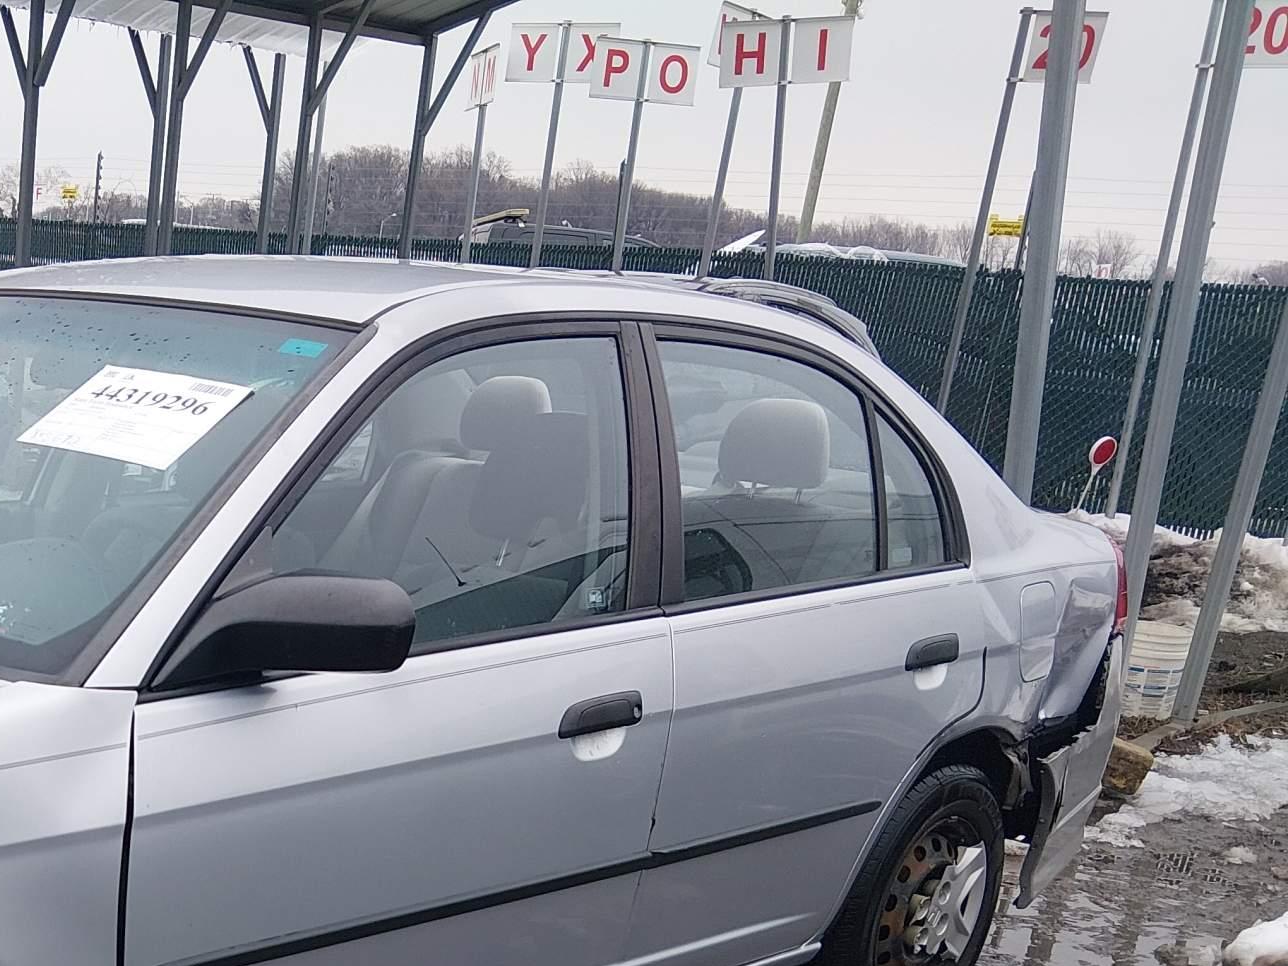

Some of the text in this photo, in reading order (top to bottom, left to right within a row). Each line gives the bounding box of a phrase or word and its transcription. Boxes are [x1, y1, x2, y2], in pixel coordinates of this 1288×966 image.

[521, 33, 548, 72] Y
[603, 48, 630, 88] P
[734, 32, 767, 75] H
[817, 29, 829, 71] I
[91, 384, 217, 416] 44319296
